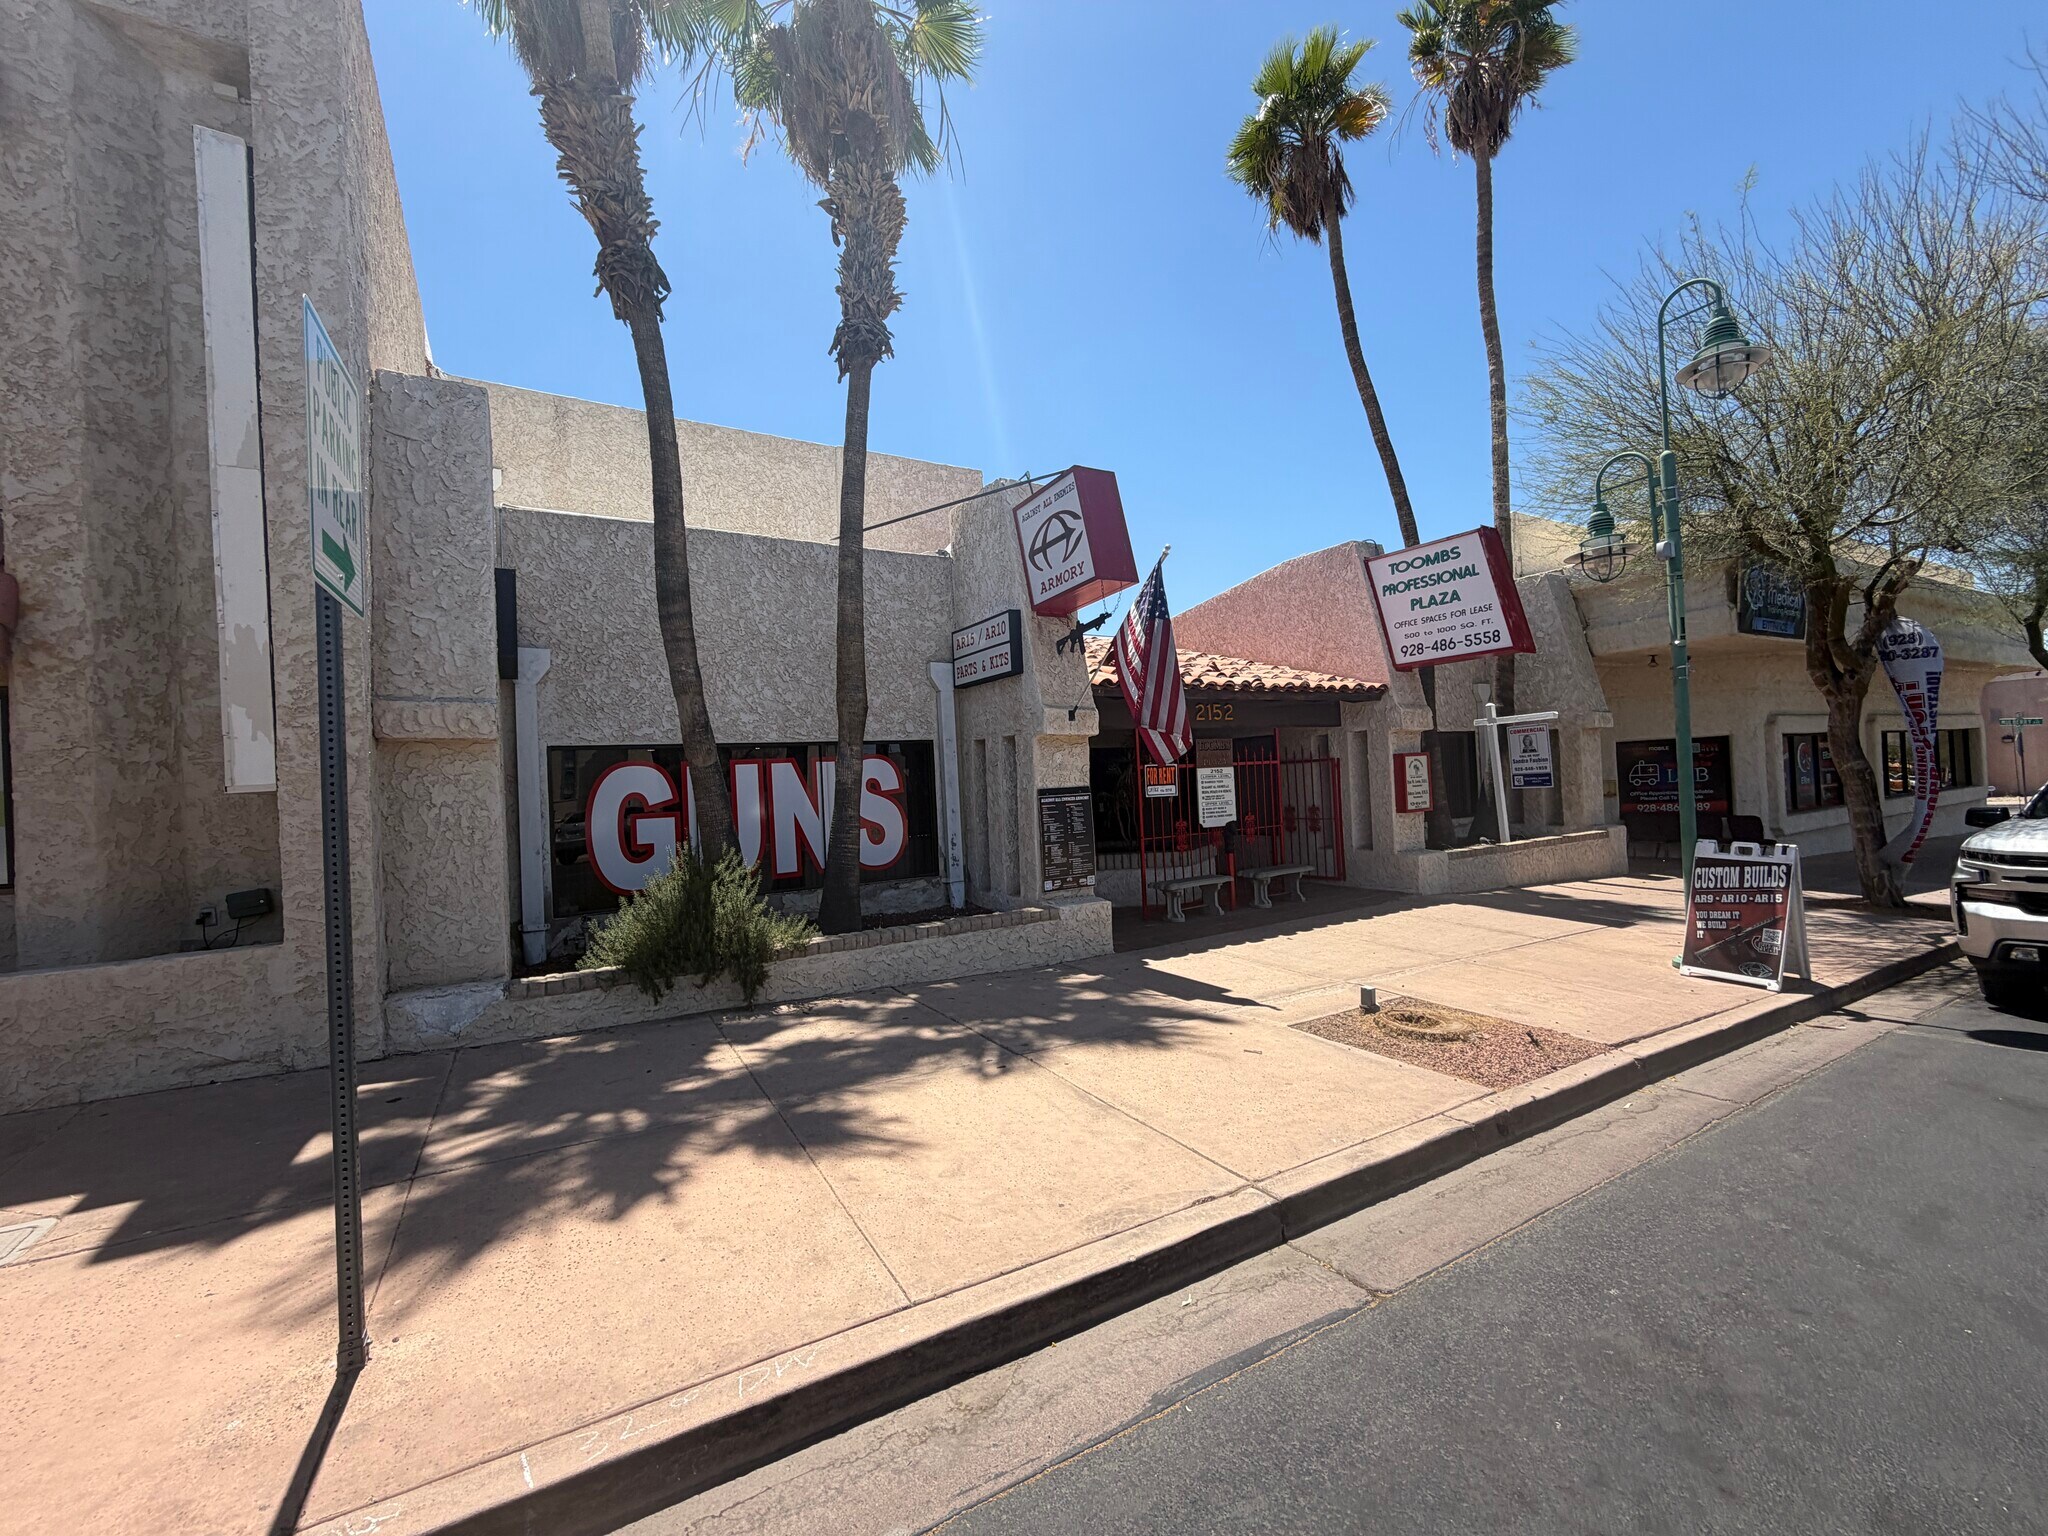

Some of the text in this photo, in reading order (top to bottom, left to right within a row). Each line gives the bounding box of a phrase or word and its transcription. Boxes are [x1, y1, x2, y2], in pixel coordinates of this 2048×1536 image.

[316, 334, 351, 434] PUBLIC
[313, 386, 357, 492] PARKING
[316, 452, 357, 545] IN REAR
[1021, 481, 1076, 523] AGAINST ALL ENEMIES
[1388, 546, 1461, 575] TOOMBS
[1040, 561, 1085, 595] ARMORY
[1382, 563, 1480, 597] PROFESSIONAL
[1410, 589, 1462, 611] PLAZA
[1394, 603, 1493, 630] OFFICE SPACES FOR LEASE
[1404, 631, 1420, 639] 500
[1437, 625, 1456, 633] 1000
[1460, 621, 1477, 630] SQ.
[1481, 618, 1494, 626] FT.
[956, 632, 975, 651] AR15
[985, 620, 1007, 641] AR10
[1400, 629, 1501, 658] 928-486-5558
[1883, 632, 1924, 649] (928)
[956, 651, 1009, 680] PARTS & KITS
[1196, 704, 1234, 721] 2152
[1147, 766, 1175, 785] FOR RENT
[1667, 767, 1709, 783] LB
[585, 753, 908, 895] GUNS
[1694, 864, 1787, 889] CUSTOM BUILDS
[1696, 911, 1740, 919] YOU DREAM IT
[1696, 920, 1727, 929] WE BUILD
[1696, 930, 1704, 939] IT
